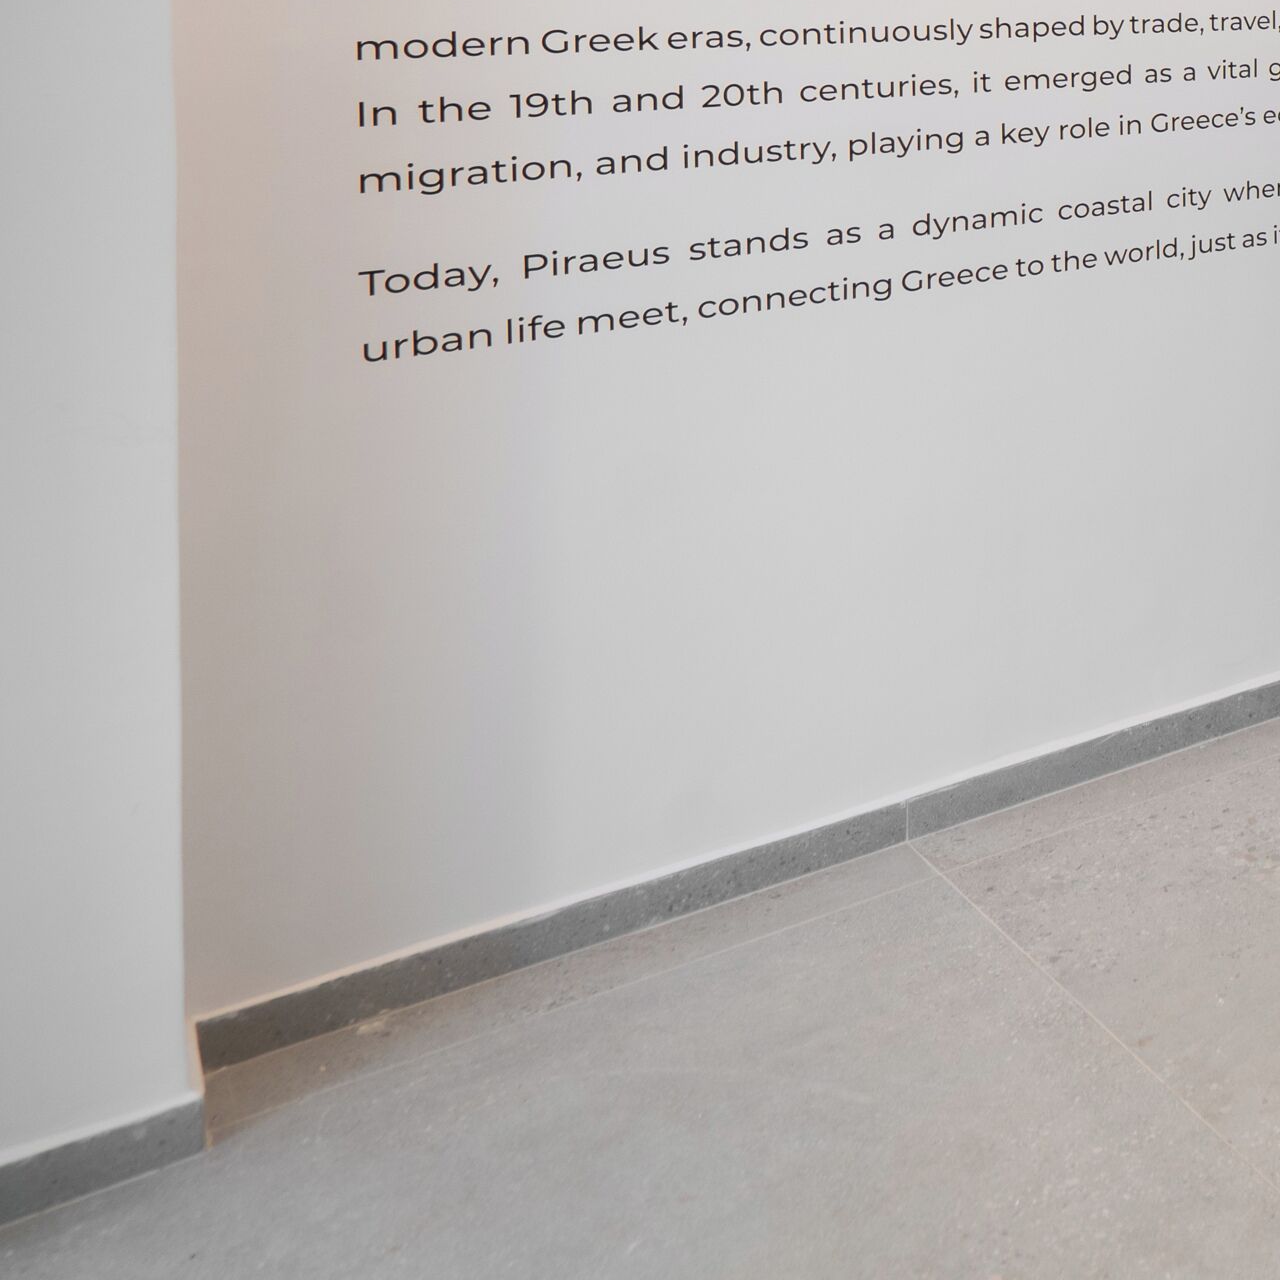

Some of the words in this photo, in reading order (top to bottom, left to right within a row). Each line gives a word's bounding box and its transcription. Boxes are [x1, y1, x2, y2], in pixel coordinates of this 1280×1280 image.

[356, 30, 530, 61] modern
[541, 25, 660, 55] Greek
[667, 29, 752, 53] eras,
[759, 17, 974, 47] continuously
[979, 14, 1085, 44] shaped
[1093, 14, 1125, 41] by
[1128, 11, 1205, 37] trade,
[358, 101, 397, 128] In
[417, 95, 492, 124] the
[508, 89, 593, 119] 19th
[612, 84, 684, 114] and
[700, 80, 783, 109] 20th
[799, 73, 960, 103] centuries,
[973, 70, 993, 94] it
[1004, 63, 1132, 93] emerged
[1144, 67, 1173, 84] as
[1182, 66, 1196, 82] a
[1206, 57, 1258, 81] vital
[359, 155, 583, 196] migration,
[595, 145, 669, 176] and
[682, 139, 837, 169] industry,
[848, 127, 964, 163] playing
[974, 129, 990, 147] a
[1001, 122, 1051, 148] key
[1059, 116, 1111, 141] role
[1119, 113, 1142, 136] in
[357, 262, 499, 297] Today,
[523, 246, 671, 280] Piraeus
[688, 226, 809, 261] stands
[826, 226, 862, 246] as
[878, 222, 895, 241] a
[912, 202, 1044, 241] dynamic
[1057, 189, 1153, 221] coastal
[1166, 186, 1213, 211] city
[363, 328, 493, 363] urban
[506, 314, 566, 345] life
[577, 301, 689, 336] meet,
[697, 276, 892, 319] connecting
[901, 263, 1009, 292] Greece
[1014, 258, 1045, 278] to
[1050, 249, 1098, 273] the
[1103, 236, 1185, 266] world,
[1187, 232, 1237, 261] just
[1241, 231, 1268, 249] as
